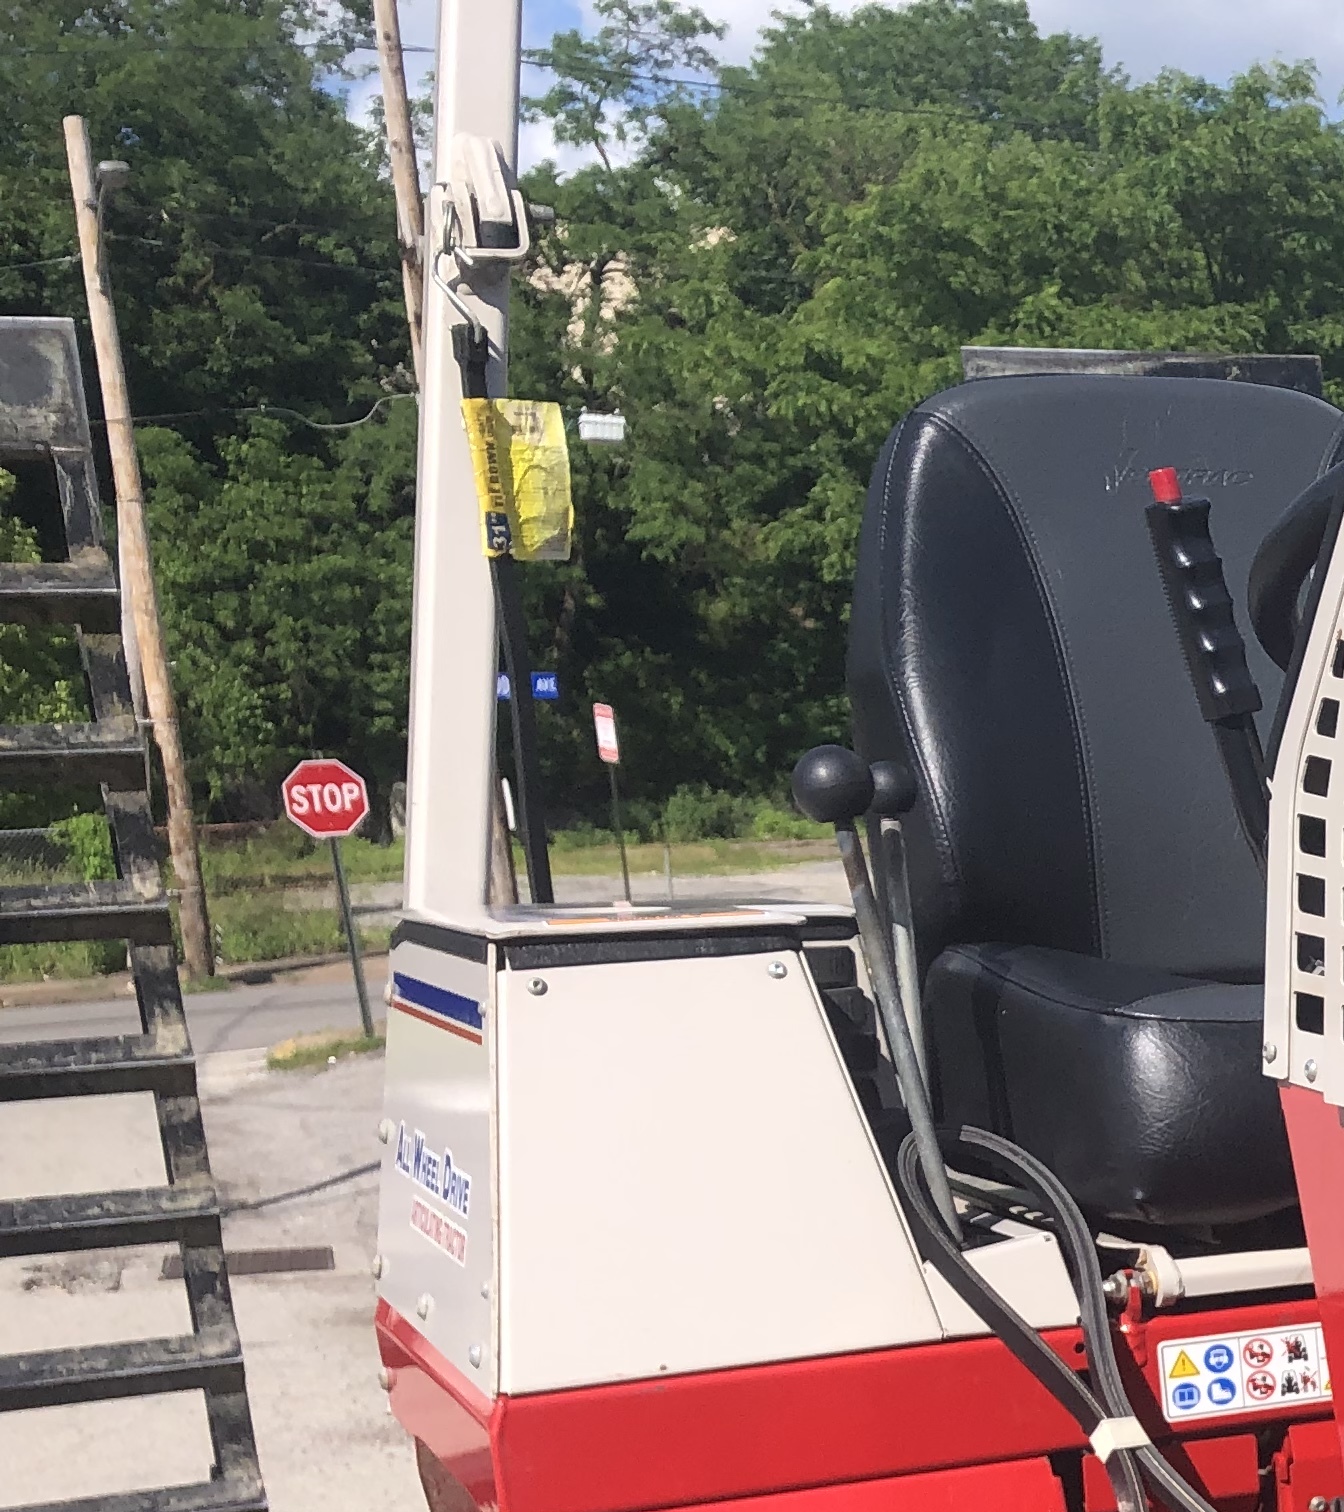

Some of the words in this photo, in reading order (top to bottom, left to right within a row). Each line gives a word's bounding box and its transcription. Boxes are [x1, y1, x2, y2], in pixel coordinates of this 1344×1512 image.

[290, 782, 360, 815] STOP
[413, 1132, 440, 1195] WHEEL
[442, 1154, 470, 1215] DRIVE
